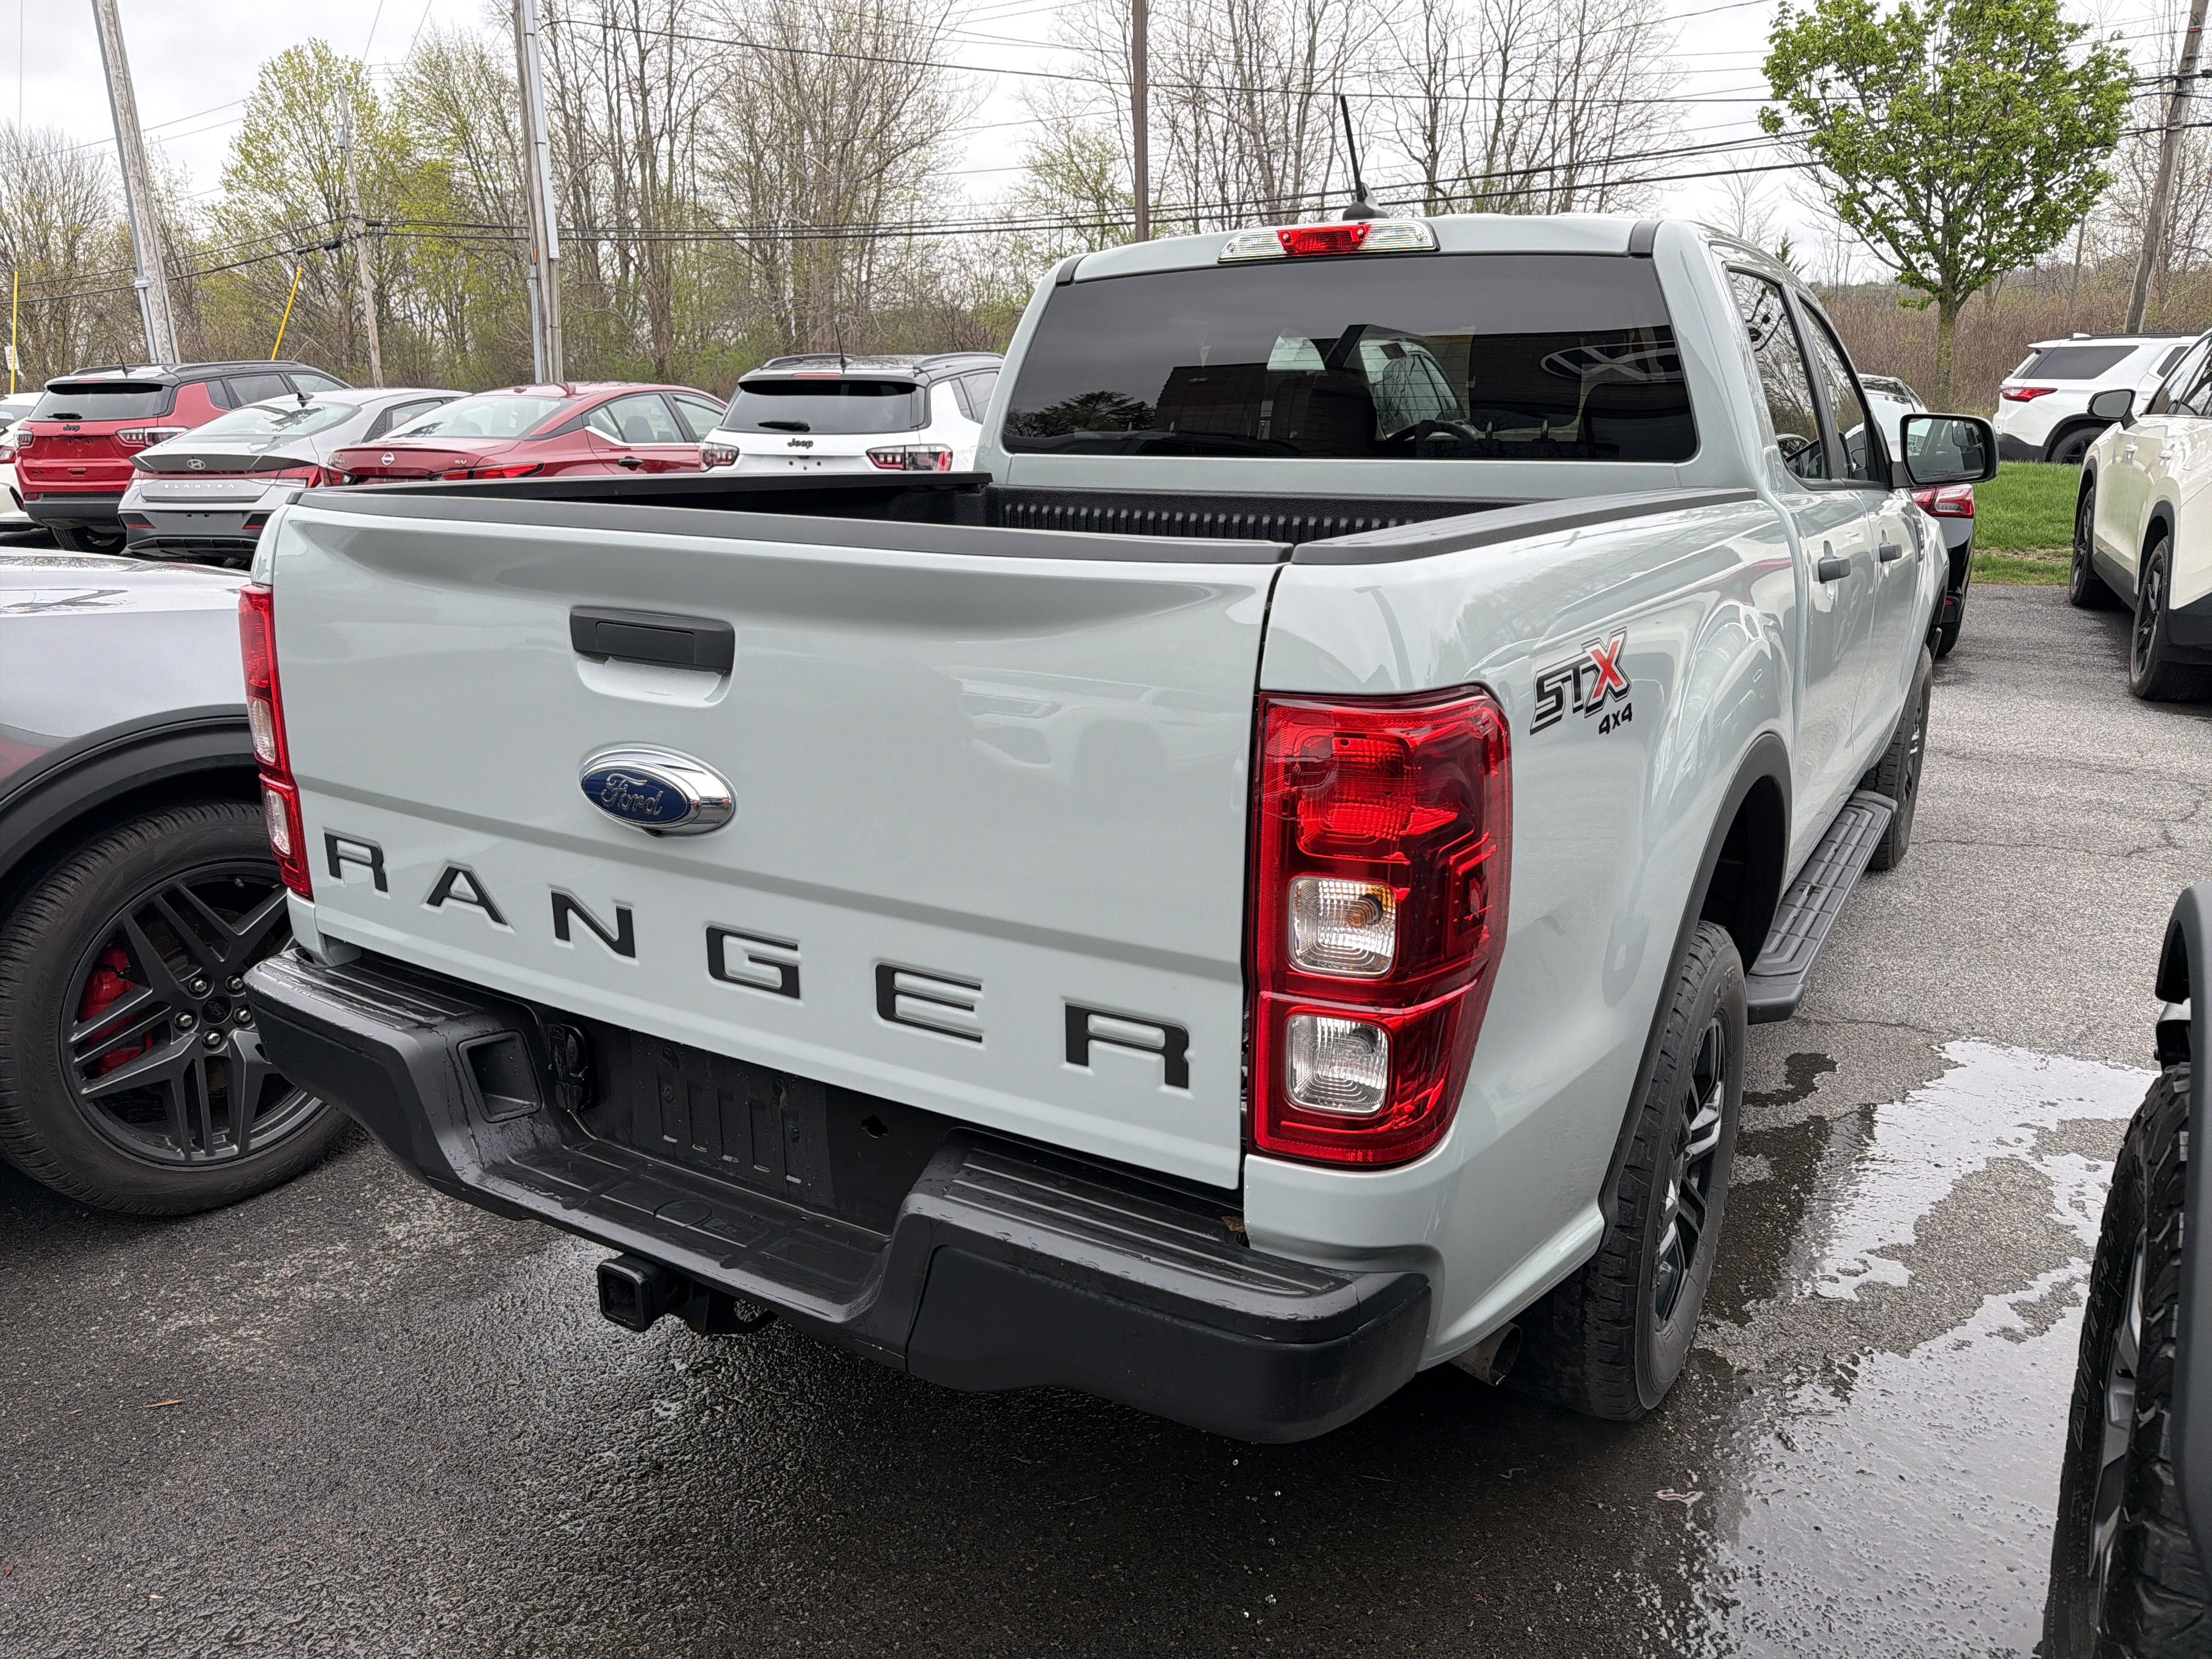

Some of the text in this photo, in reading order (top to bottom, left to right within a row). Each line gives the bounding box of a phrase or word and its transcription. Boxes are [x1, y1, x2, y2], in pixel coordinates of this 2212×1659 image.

[787, 438, 814, 449] Jeep
[1530, 625, 1632, 736] STX
[600, 772, 664, 816] Ford
[324, 830, 1189, 1089] RANGER
